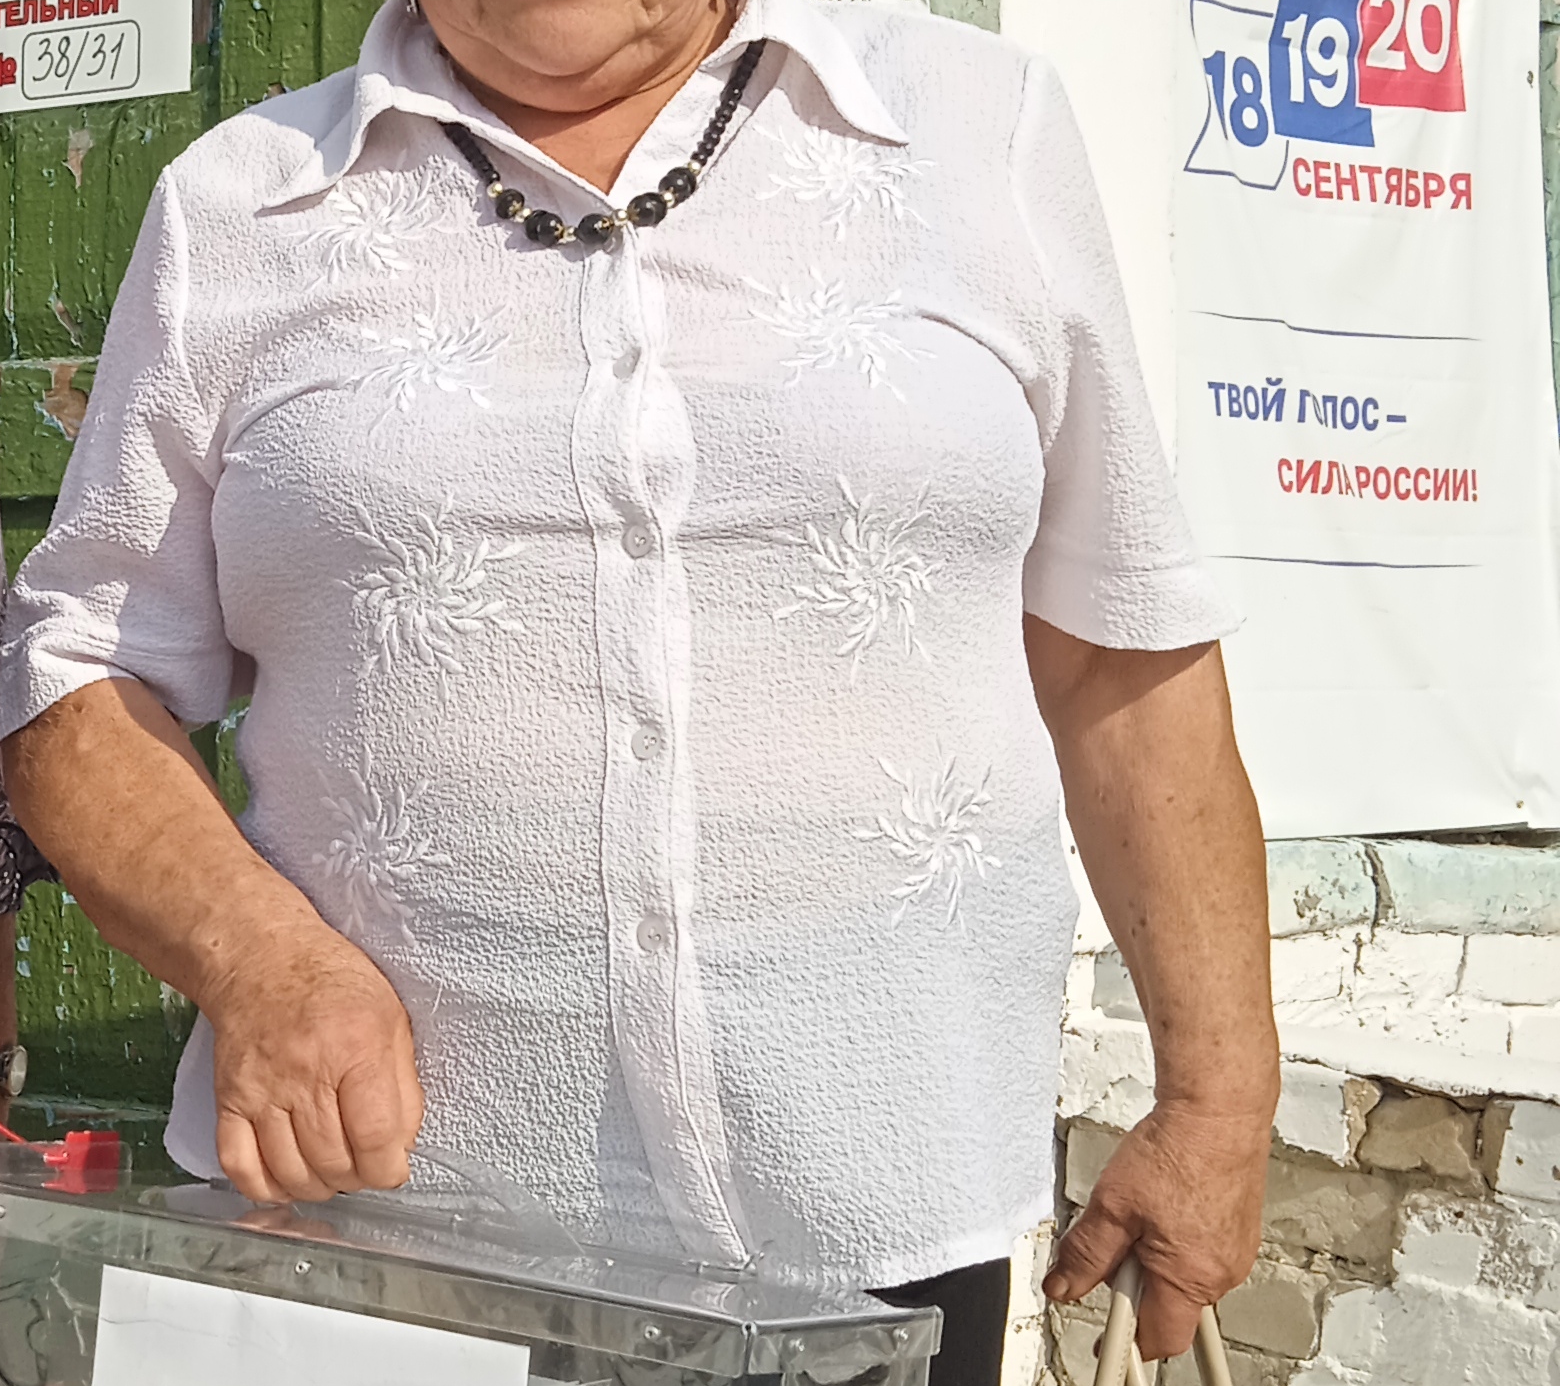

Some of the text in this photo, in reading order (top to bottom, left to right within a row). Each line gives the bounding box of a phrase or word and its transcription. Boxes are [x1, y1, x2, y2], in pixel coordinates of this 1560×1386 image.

[32, 31, 126, 91] 38/31
[1202, 49, 1269, 148] 18
[1282, 13, 1350, 108] 19
[1292, 157, 1473, 210] СЕНТЯБРЯ
[1207, 377, 1287, 424] ТВОЙ
[1277, 457, 1478, 502] СИЛА РОССИИ!
